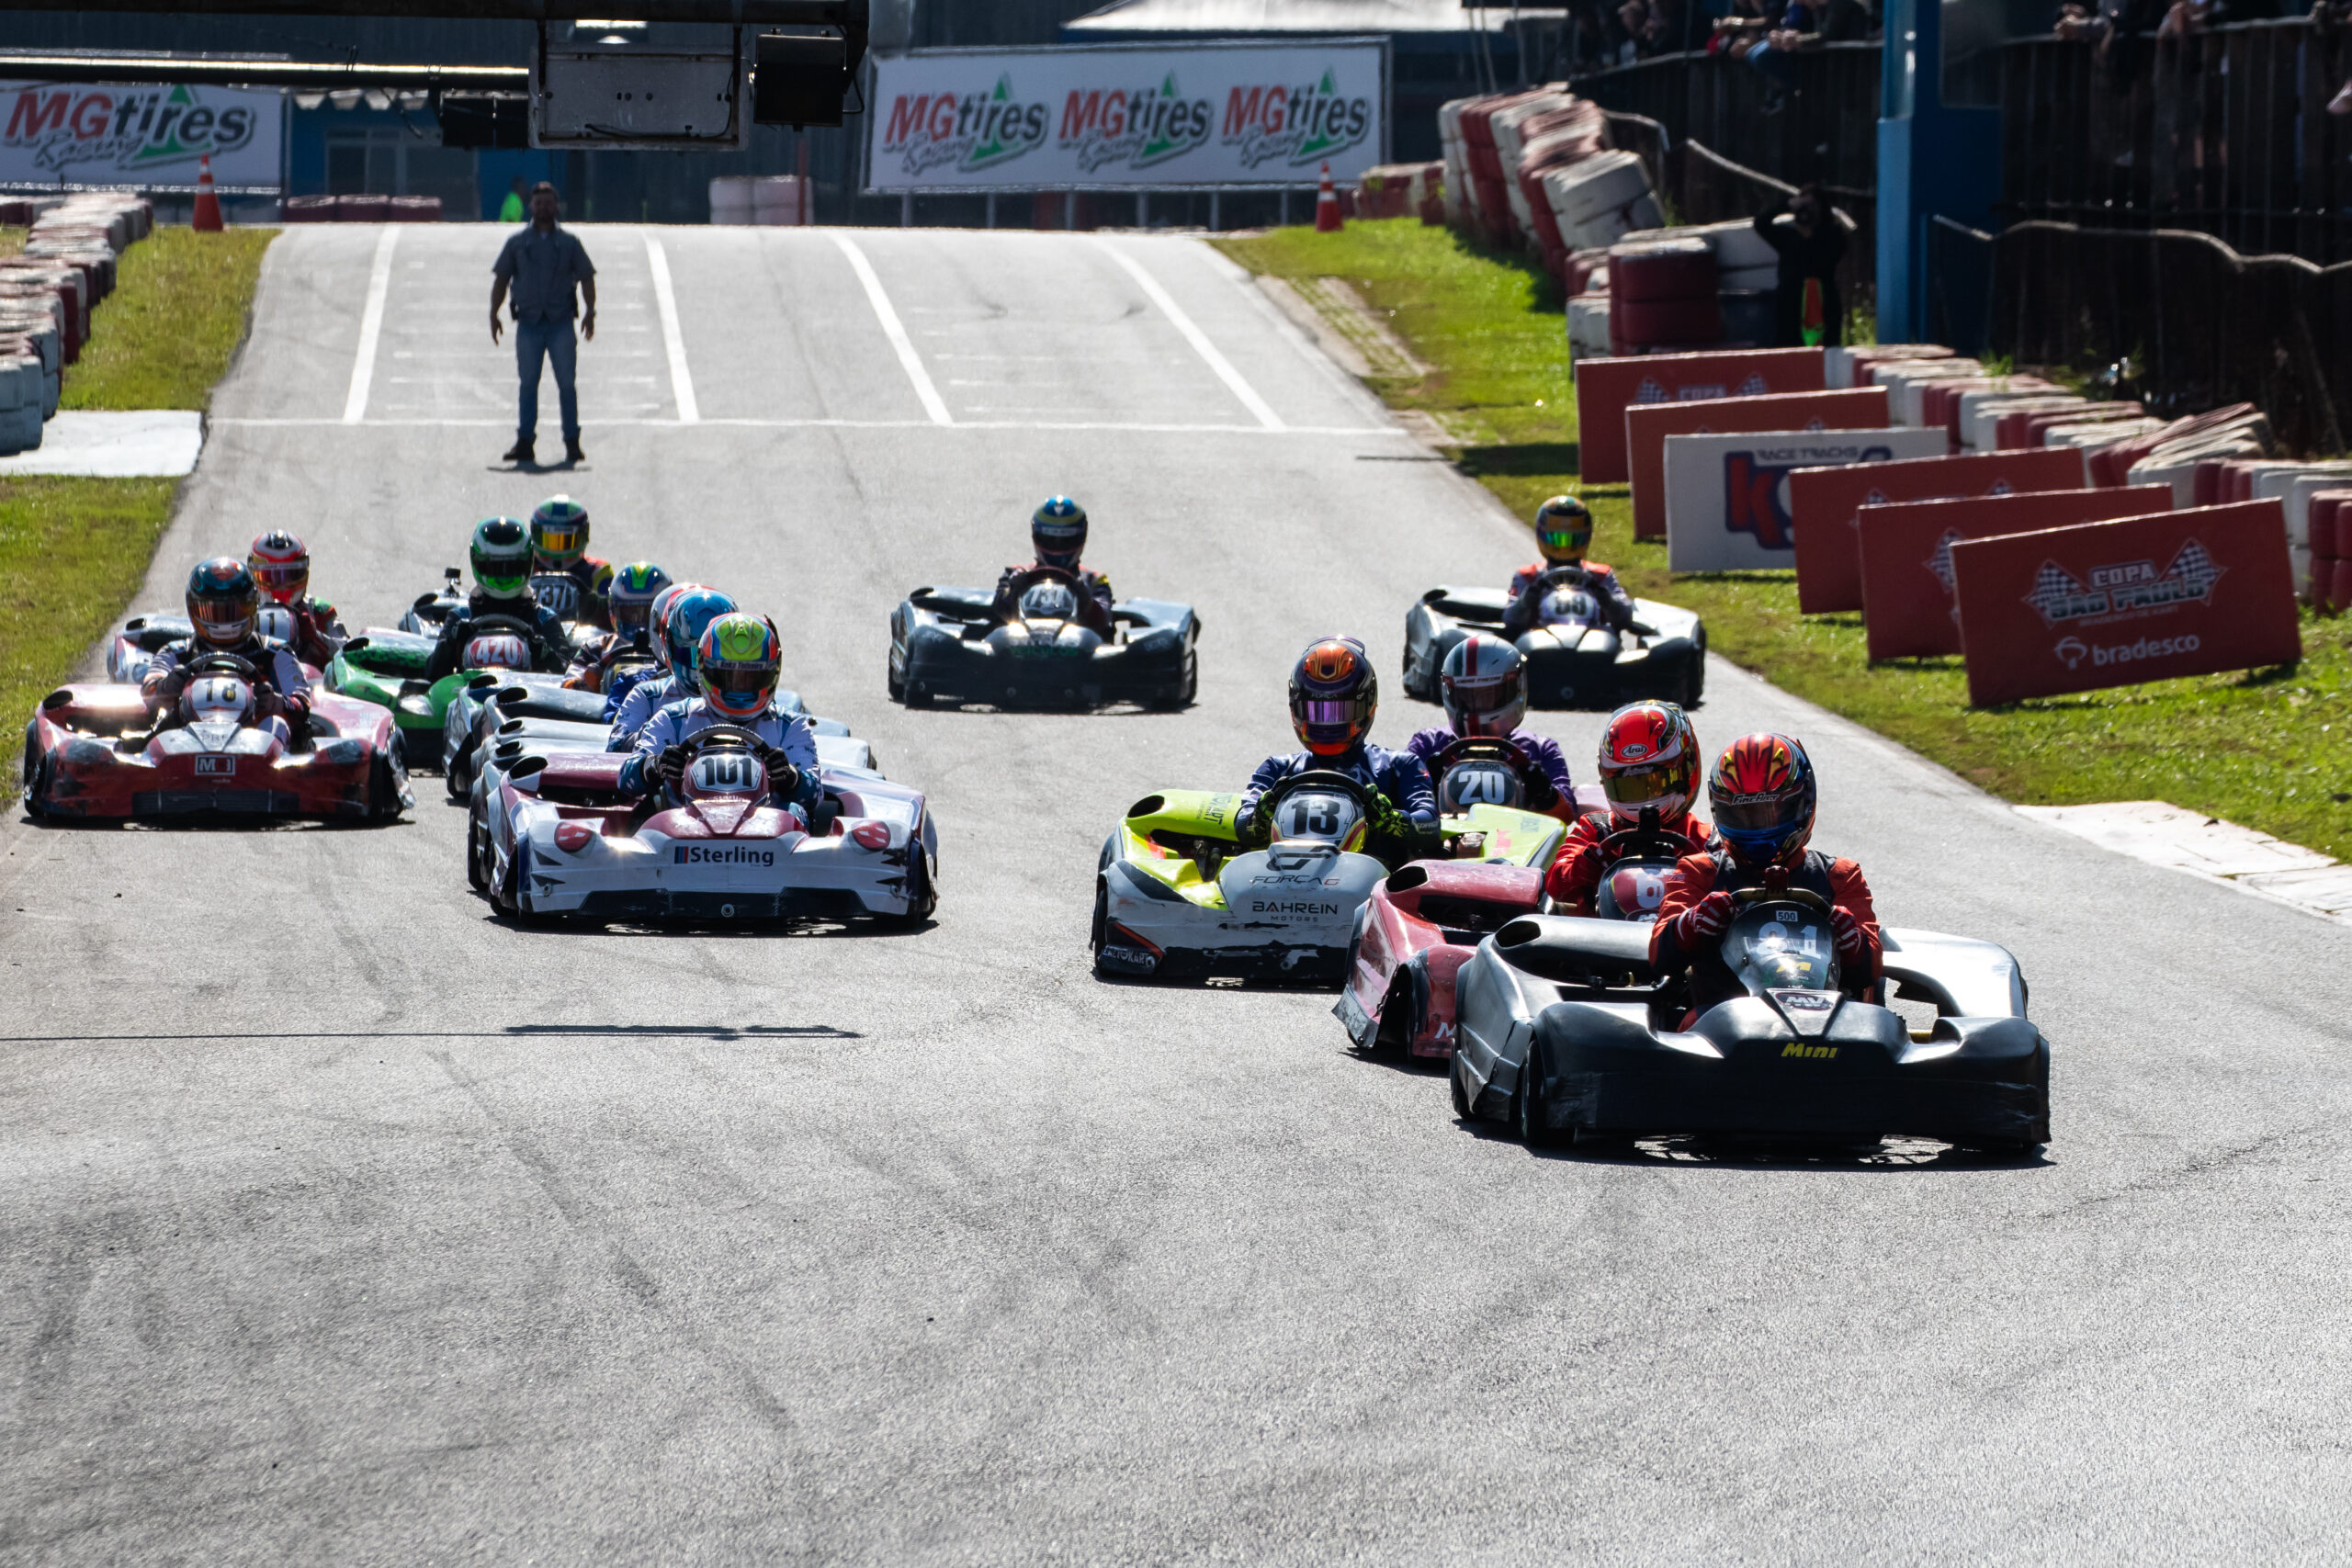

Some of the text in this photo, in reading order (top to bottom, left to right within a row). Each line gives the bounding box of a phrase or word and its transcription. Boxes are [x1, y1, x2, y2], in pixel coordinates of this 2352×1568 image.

[5, 91, 249, 144] MGtires
[884, 92, 1045, 143] MGtires
[1059, 88, 1209, 140] MGtires
[1223, 85, 1366, 137] MGtires
[2092, 562, 2156, 588] COPA
[2111, 577, 2209, 611] PAULO
[476, 637, 519, 664] 420
[2092, 634, 2200, 667] bradesco
[1624, 745, 1645, 754] Arai
[701, 757, 752, 787] 101
[1457, 770, 1505, 805] 20
[1291, 799, 1340, 836] 13
[690, 845, 775, 867] Sterling
[1252, 901, 1339, 915] BAHREIN
[1271, 915, 1318, 923] MOTORS
[1778, 911, 1797, 921] 500
[1757, 921, 1822, 960] 81
